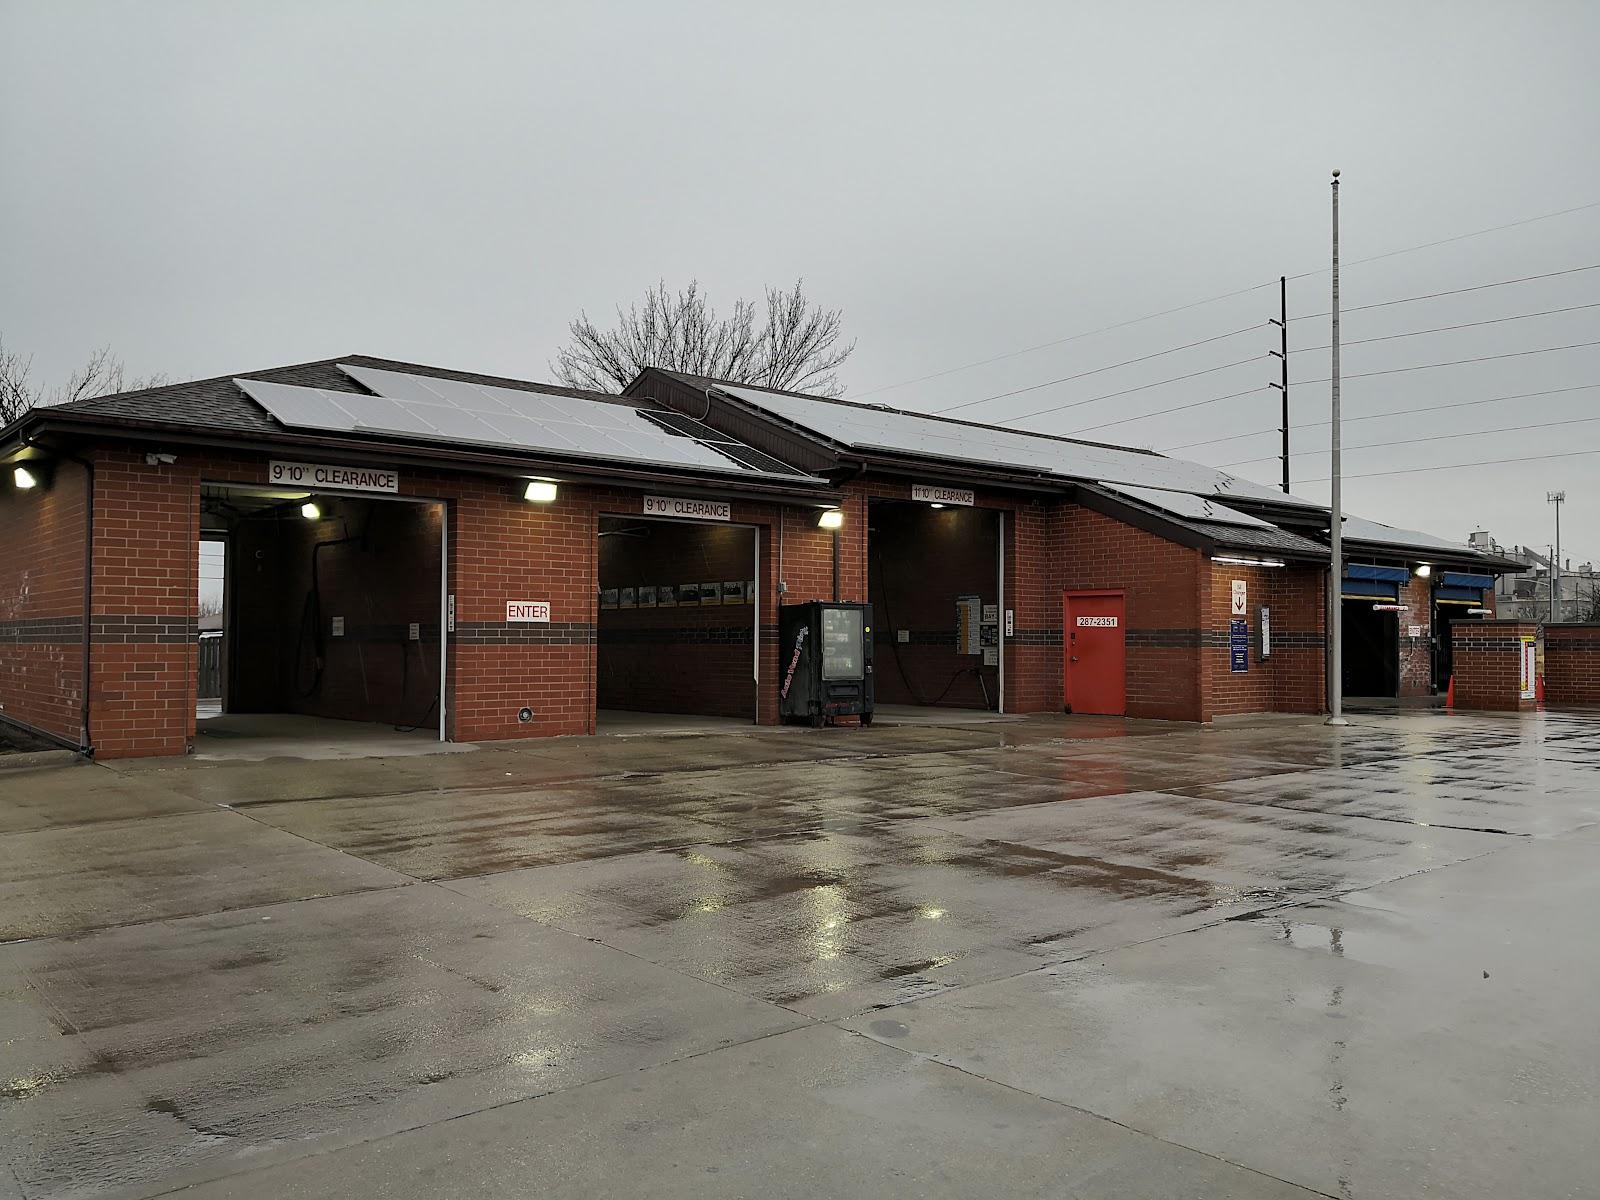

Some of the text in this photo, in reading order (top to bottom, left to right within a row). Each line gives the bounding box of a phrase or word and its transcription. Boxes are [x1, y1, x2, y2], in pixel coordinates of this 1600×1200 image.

[315, 468, 395, 489] CLEARANCE
[934, 489, 973, 503] CLEARANCE
[674, 501, 729, 517] CLEARANCE
[508, 605, 548, 618] ENTER
[1079, 617, 1115, 626] 287-2351
